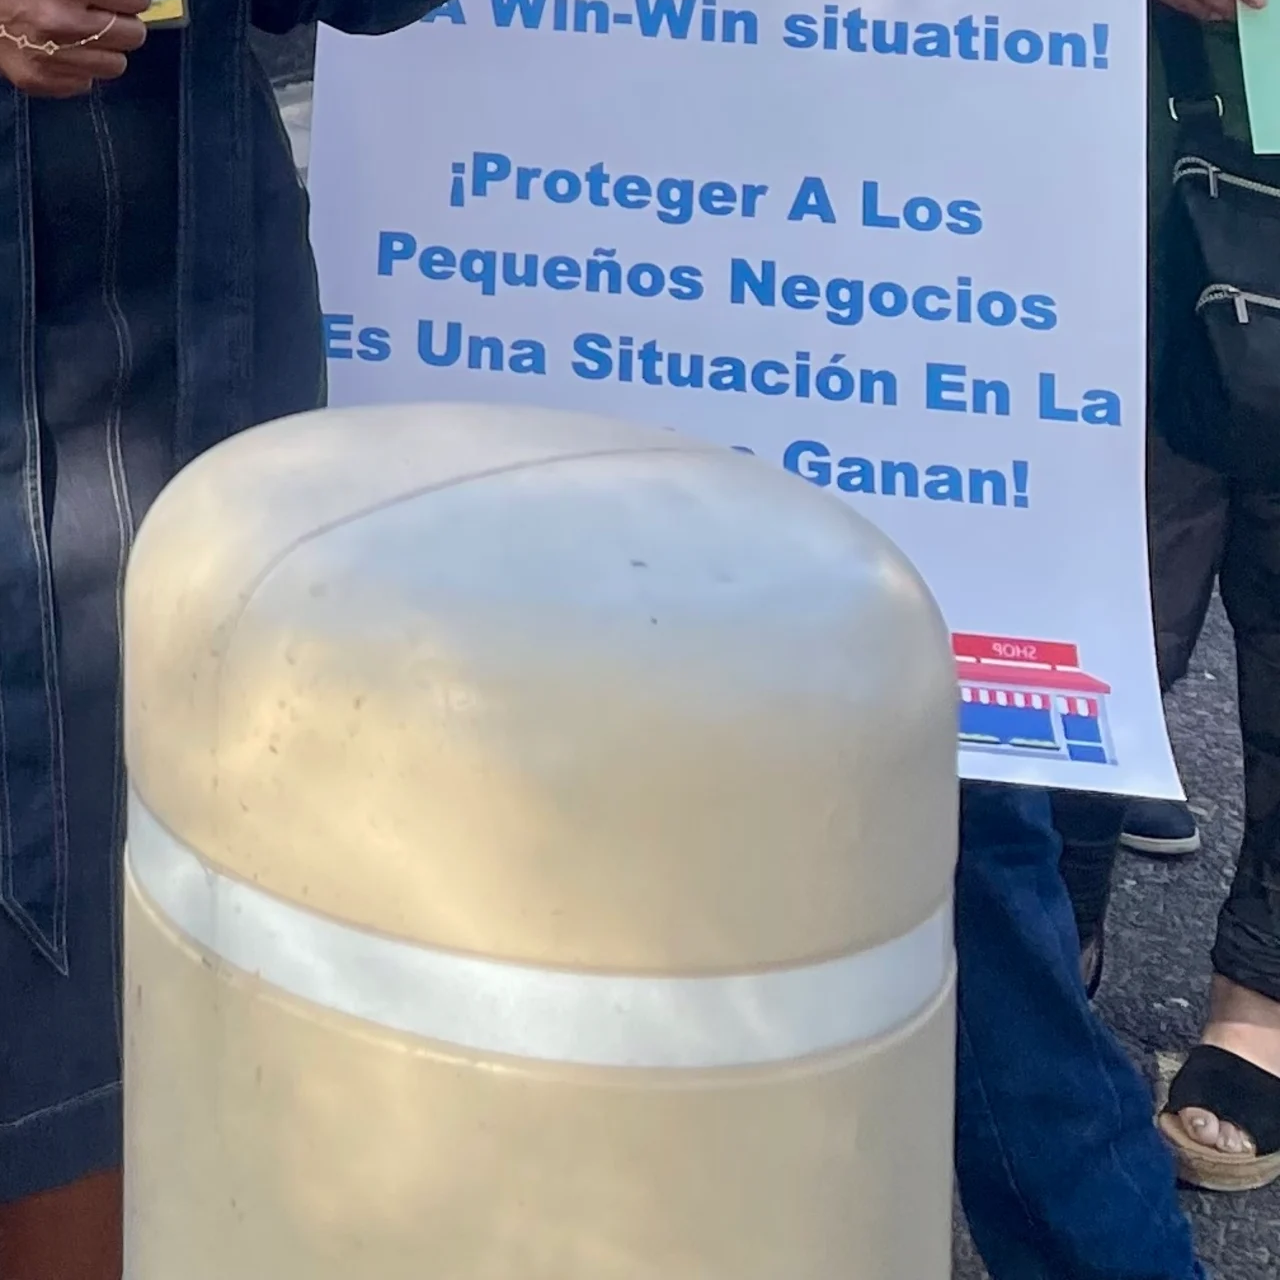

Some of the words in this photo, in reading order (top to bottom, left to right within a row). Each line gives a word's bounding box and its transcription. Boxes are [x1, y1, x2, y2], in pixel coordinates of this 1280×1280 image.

[782, 3, 1111, 71] situation!
[448, 151, 769, 226] ¡Proteger
[786, 176, 837, 225] A
[861, 180, 983, 236] Los
[376, 230, 705, 298] Pequeños
[729, 257, 1059, 332] Negocios
[322, 313, 392, 362] Es
[416, 320, 547, 377] Una
[571, 330, 899, 408] Situación
[924, 361, 1012, 418] En
[1037, 370, 1124, 428] La
[782, 439, 1031, 509] Ganan!
